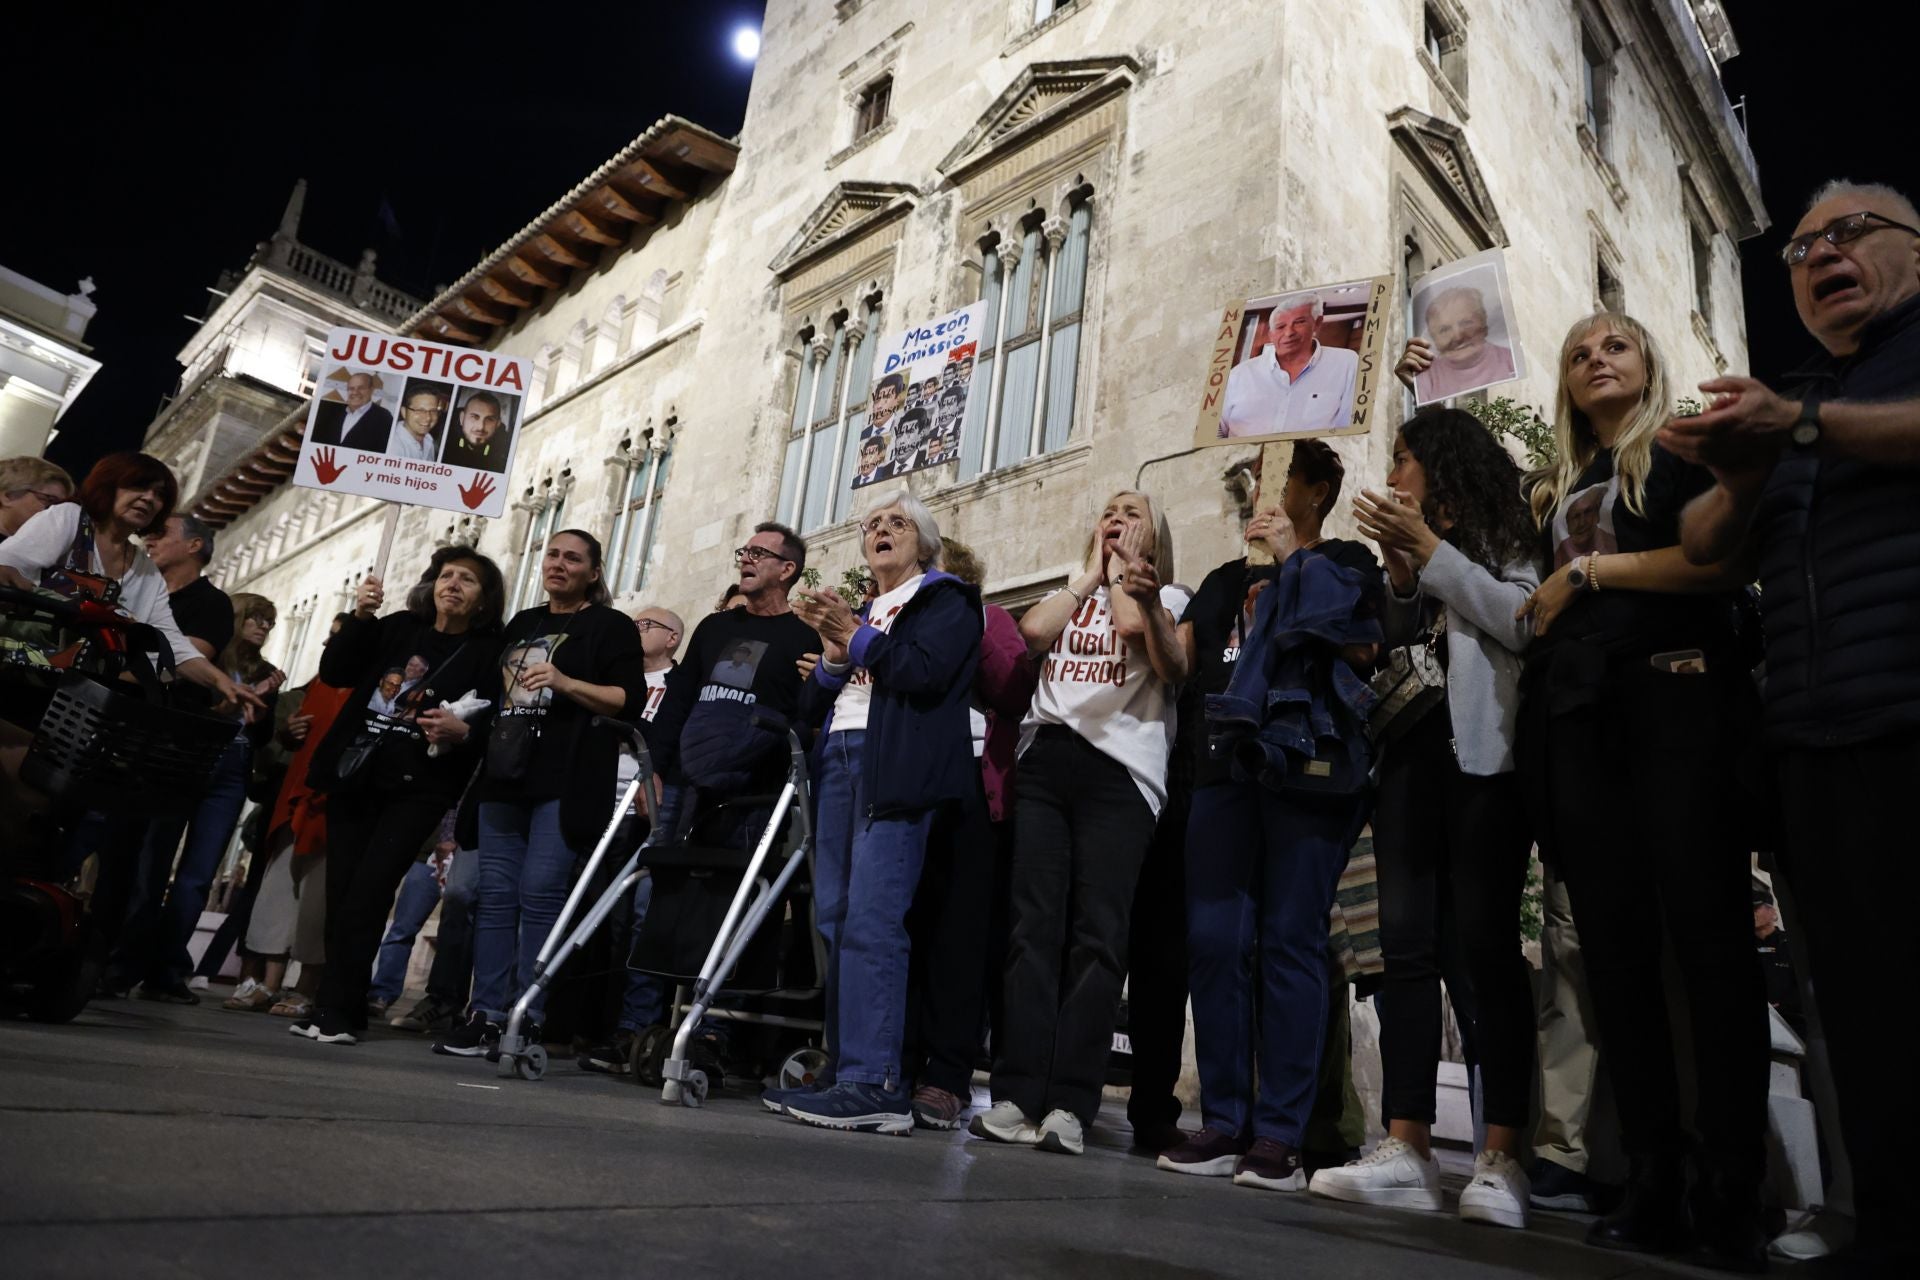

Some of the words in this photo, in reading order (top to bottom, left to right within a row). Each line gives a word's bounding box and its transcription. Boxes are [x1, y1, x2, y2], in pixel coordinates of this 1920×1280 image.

[332, 334, 523, 391] JUSTICIA
[357, 453, 381, 466] por
[385, 457, 402, 468] mi
[405, 461, 453, 477] marido
[364, 471, 374, 481] y
[377, 473, 401, 485] mis
[405, 474, 438, 491] hijos
[1060, 658, 1127, 688] PERDÓ
